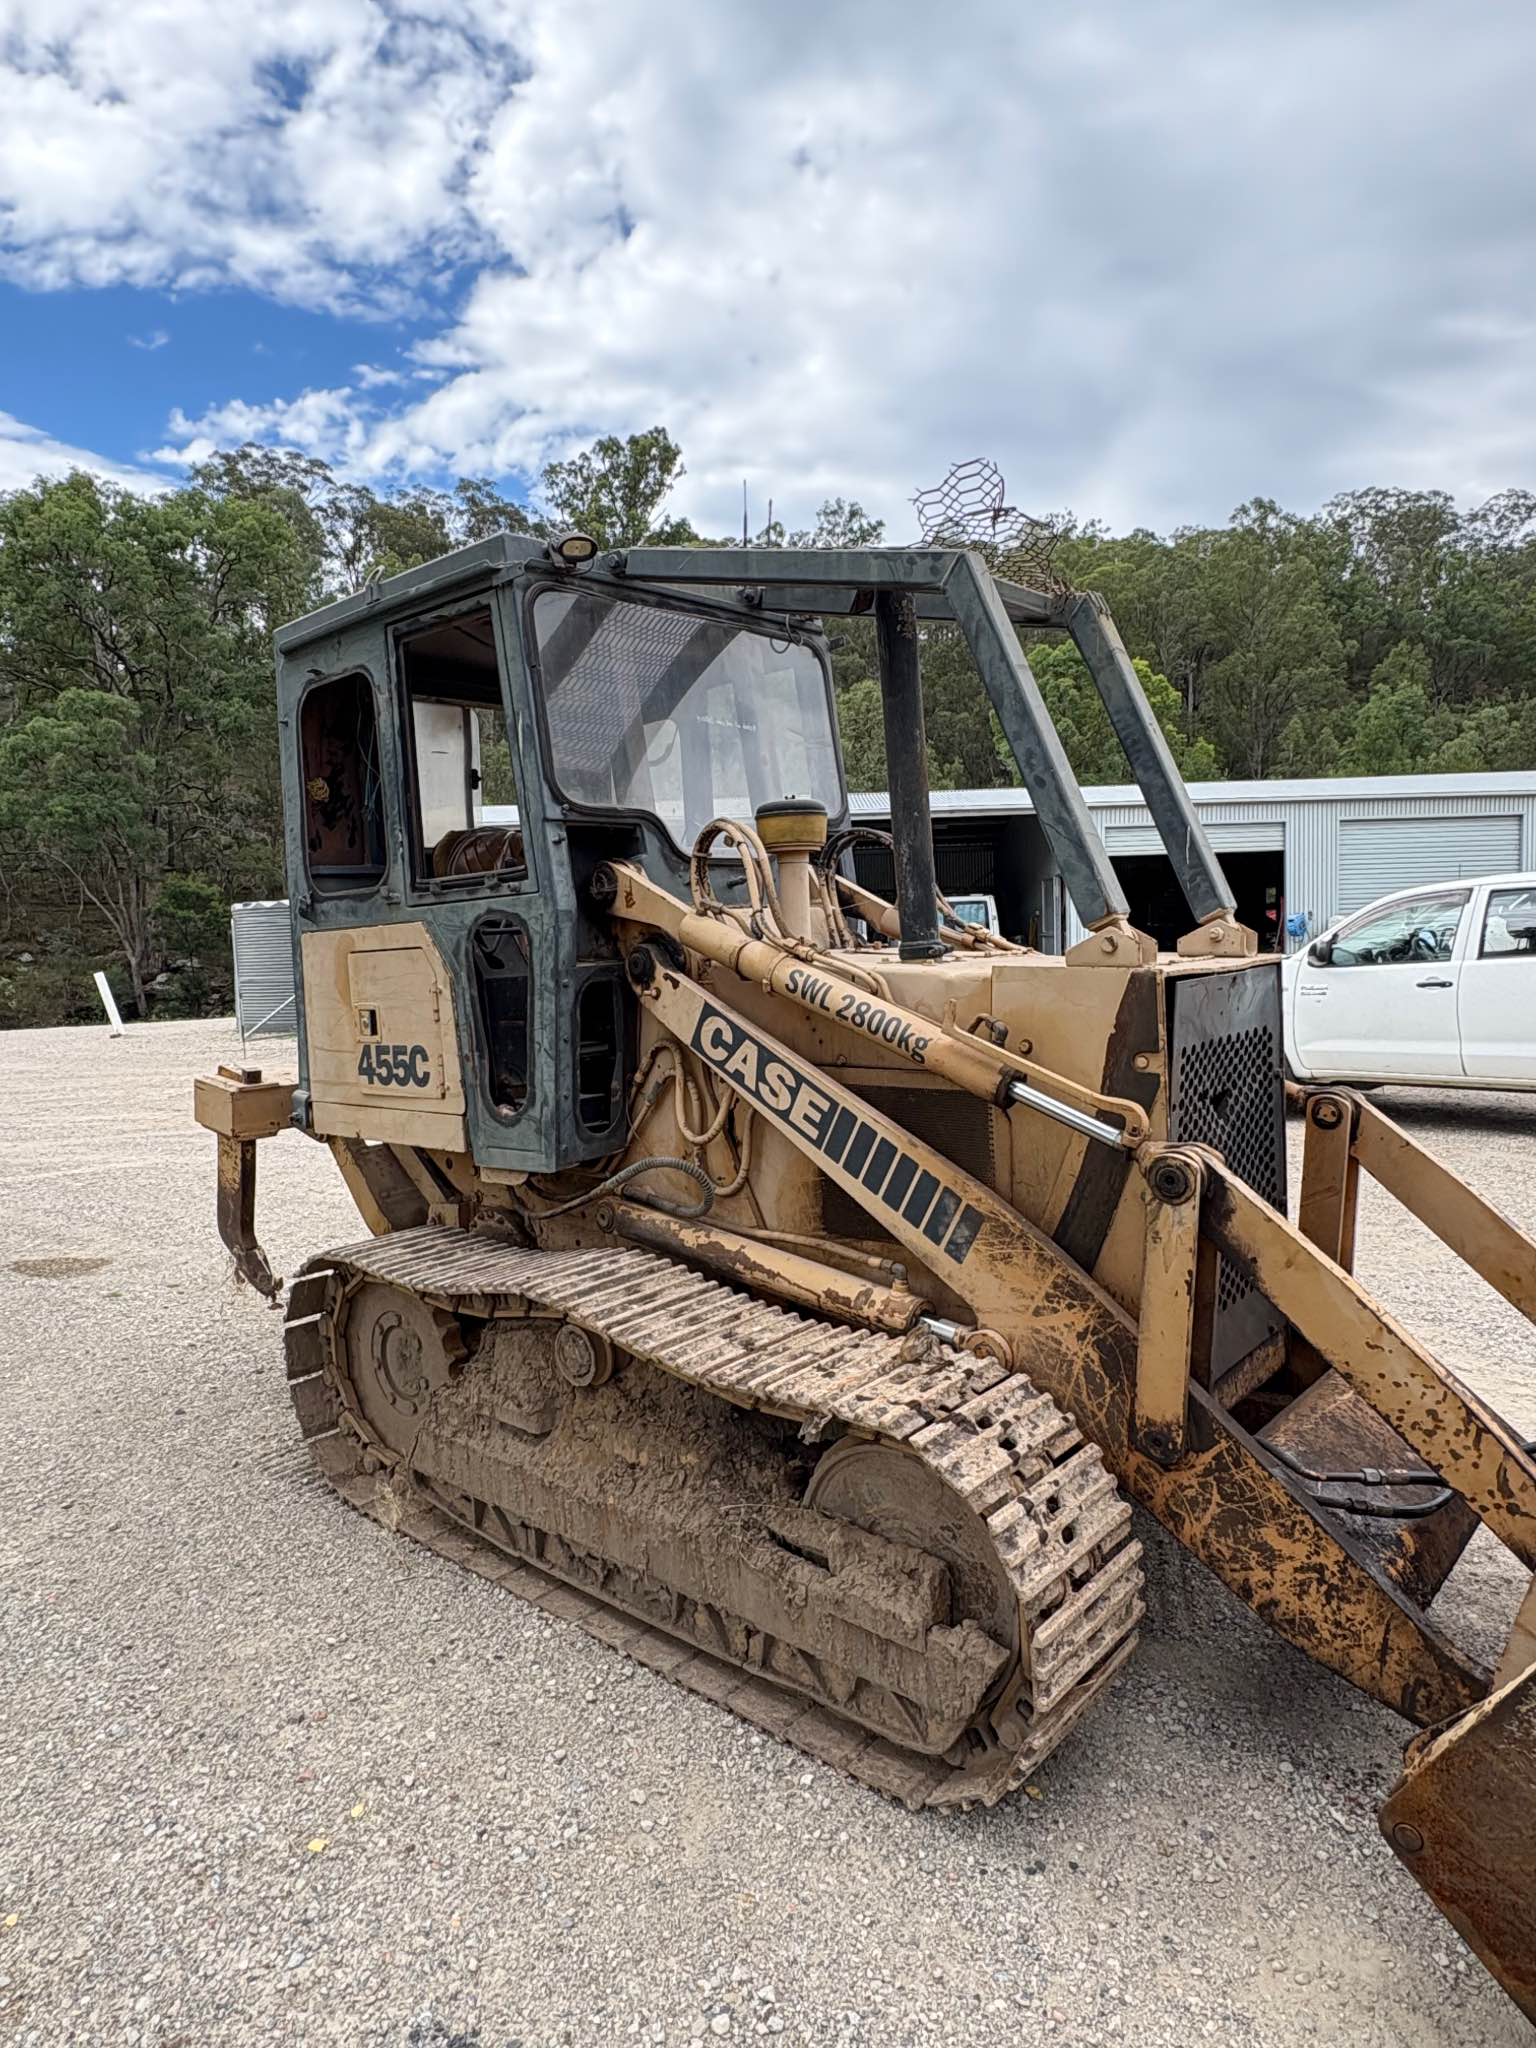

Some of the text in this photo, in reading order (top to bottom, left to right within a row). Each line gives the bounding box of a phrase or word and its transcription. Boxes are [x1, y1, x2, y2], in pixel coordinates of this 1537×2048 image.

[785, 969, 834, 1012] SWL
[358, 1044, 430, 1088] 455C
[700, 1015, 831, 1140] CASE
